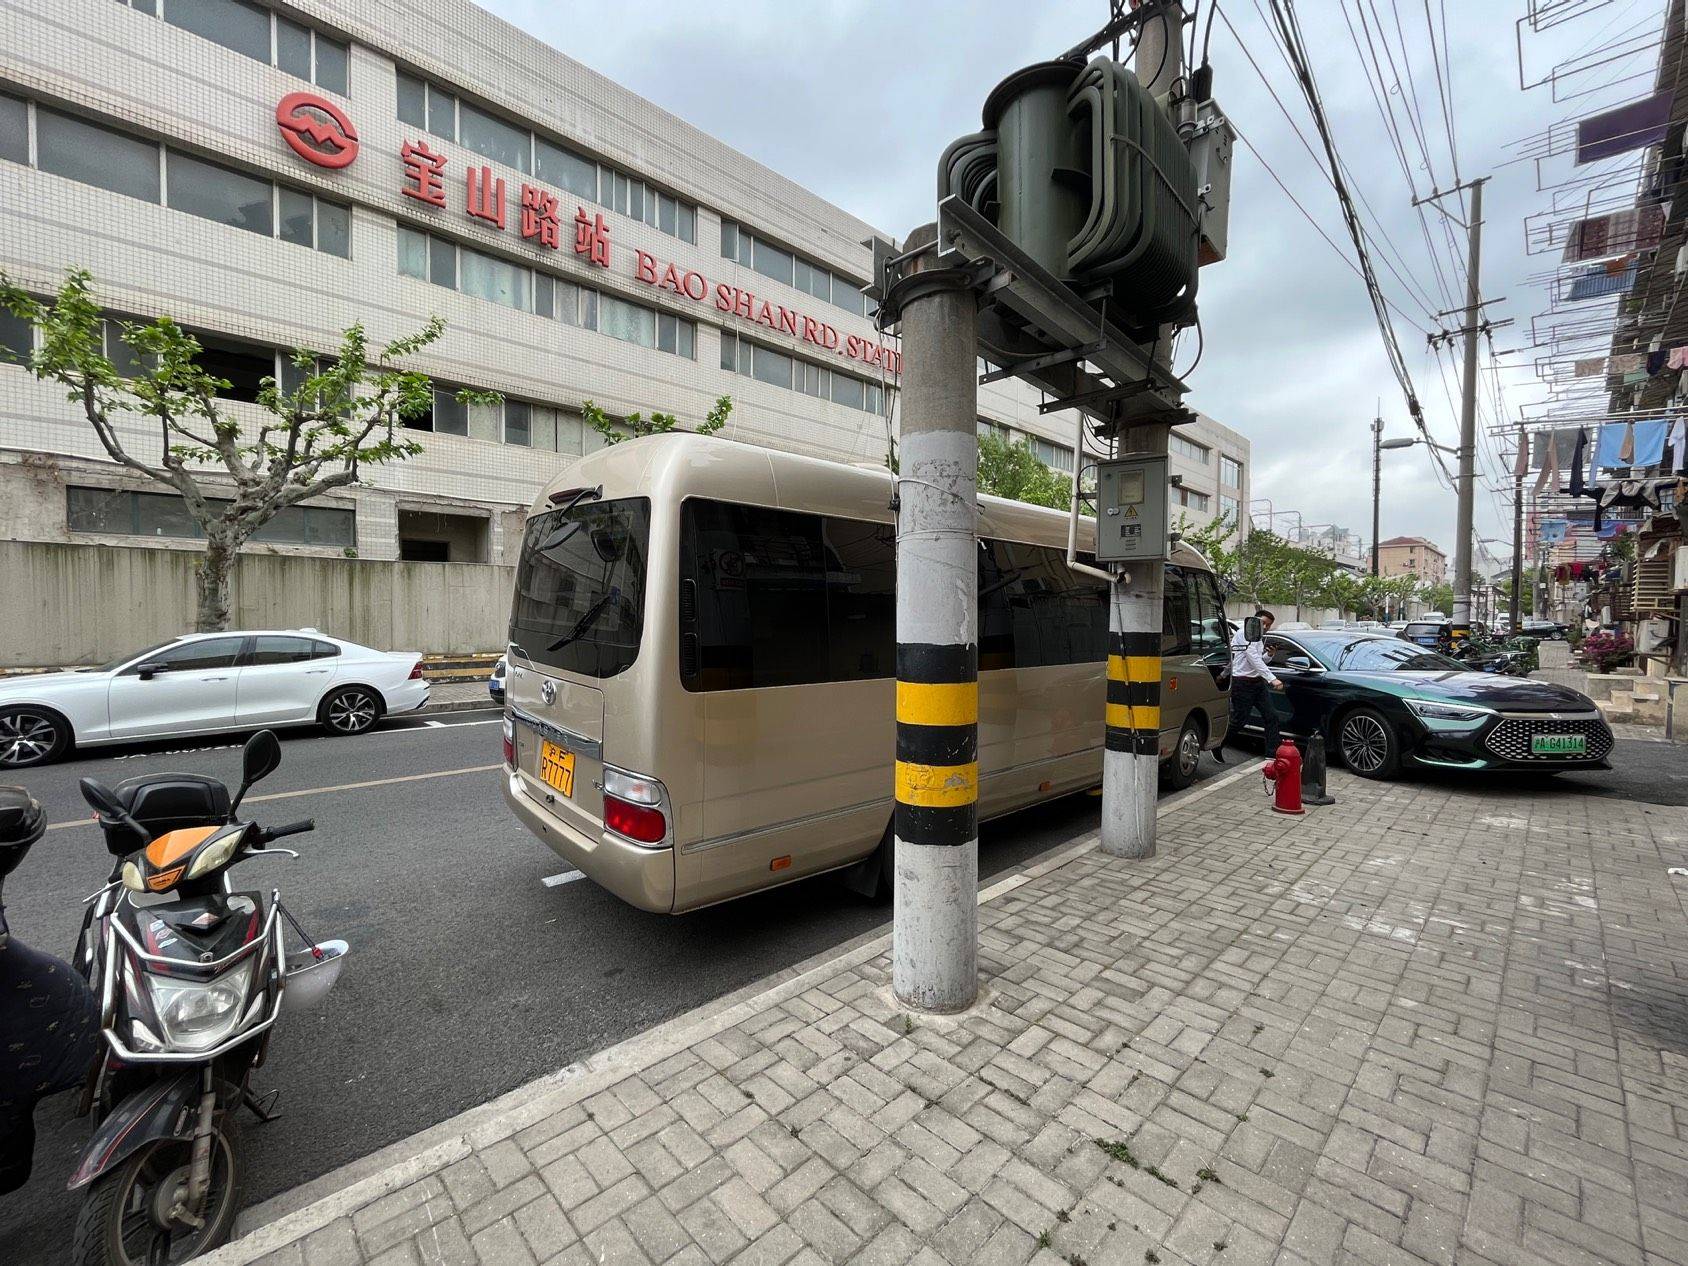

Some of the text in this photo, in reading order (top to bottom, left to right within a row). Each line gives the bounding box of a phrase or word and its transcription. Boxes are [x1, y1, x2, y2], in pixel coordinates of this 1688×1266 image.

[401, 138, 611, 268] 宝山路站
[634, 249, 709, 301] BAO
[716, 282, 799, 337] SHAN
[541, 757, 571, 793] R7777
